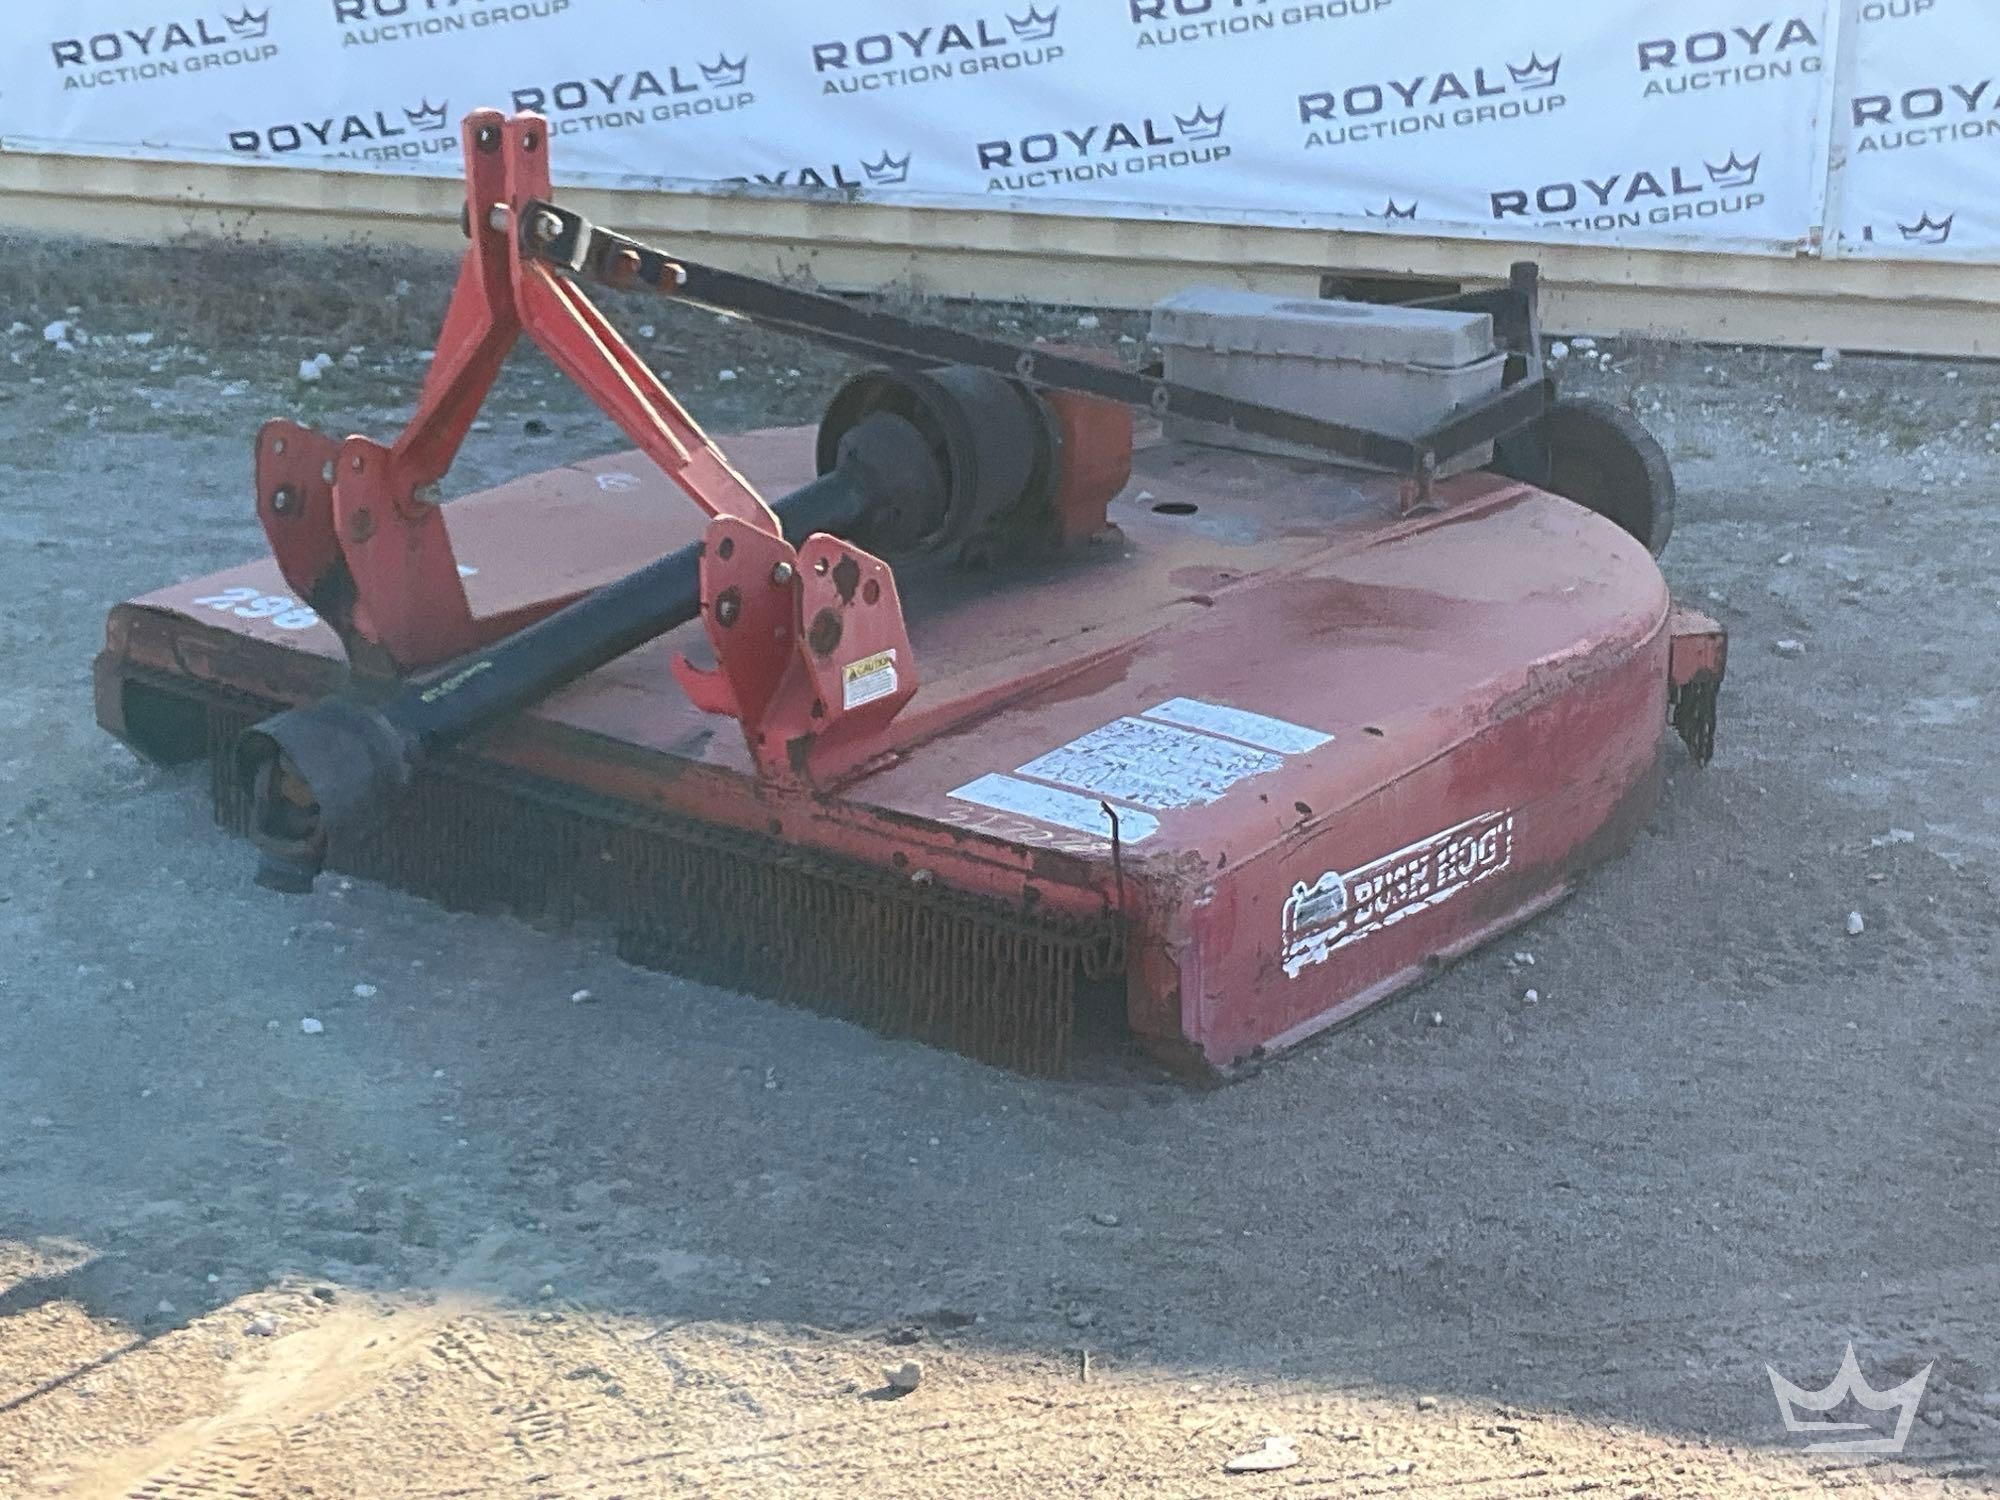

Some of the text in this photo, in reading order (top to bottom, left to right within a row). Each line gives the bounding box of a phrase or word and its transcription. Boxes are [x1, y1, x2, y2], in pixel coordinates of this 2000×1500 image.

[343, 15, 465, 46] AUCTION
[471, 0, 569, 27] GROUP
[1137, 12, 1274, 49] AUCTION
[1282, 0, 1392, 25] GROUP
[1857, 0, 1935, 23] OUP
[52, 18, 227, 69] ROYAL
[63, 44, 279, 90] AUCTION GROUP
[812, 19, 1006, 72] ROYAL
[1638, 18, 1817, 71] ROYA
[511, 66, 698, 114] ROYAL
[823, 45, 1064, 95] AUCTION GROUP
[1643, 60, 1791, 97] AUCTION
[548, 92, 756, 137] UCTION GROUP
[1299, 67, 1506, 124] ROYAL
[977, 118, 1174, 169] ROYAL
[1305, 94, 1566, 149] AUCTION GROUP
[1857, 119, 2000, 153] AUCTION
[987, 145, 1232, 193] AUCTION GROUP
[1490, 166, 1703, 219] ROYAL
[1650, 193, 1765, 224] GROUP
